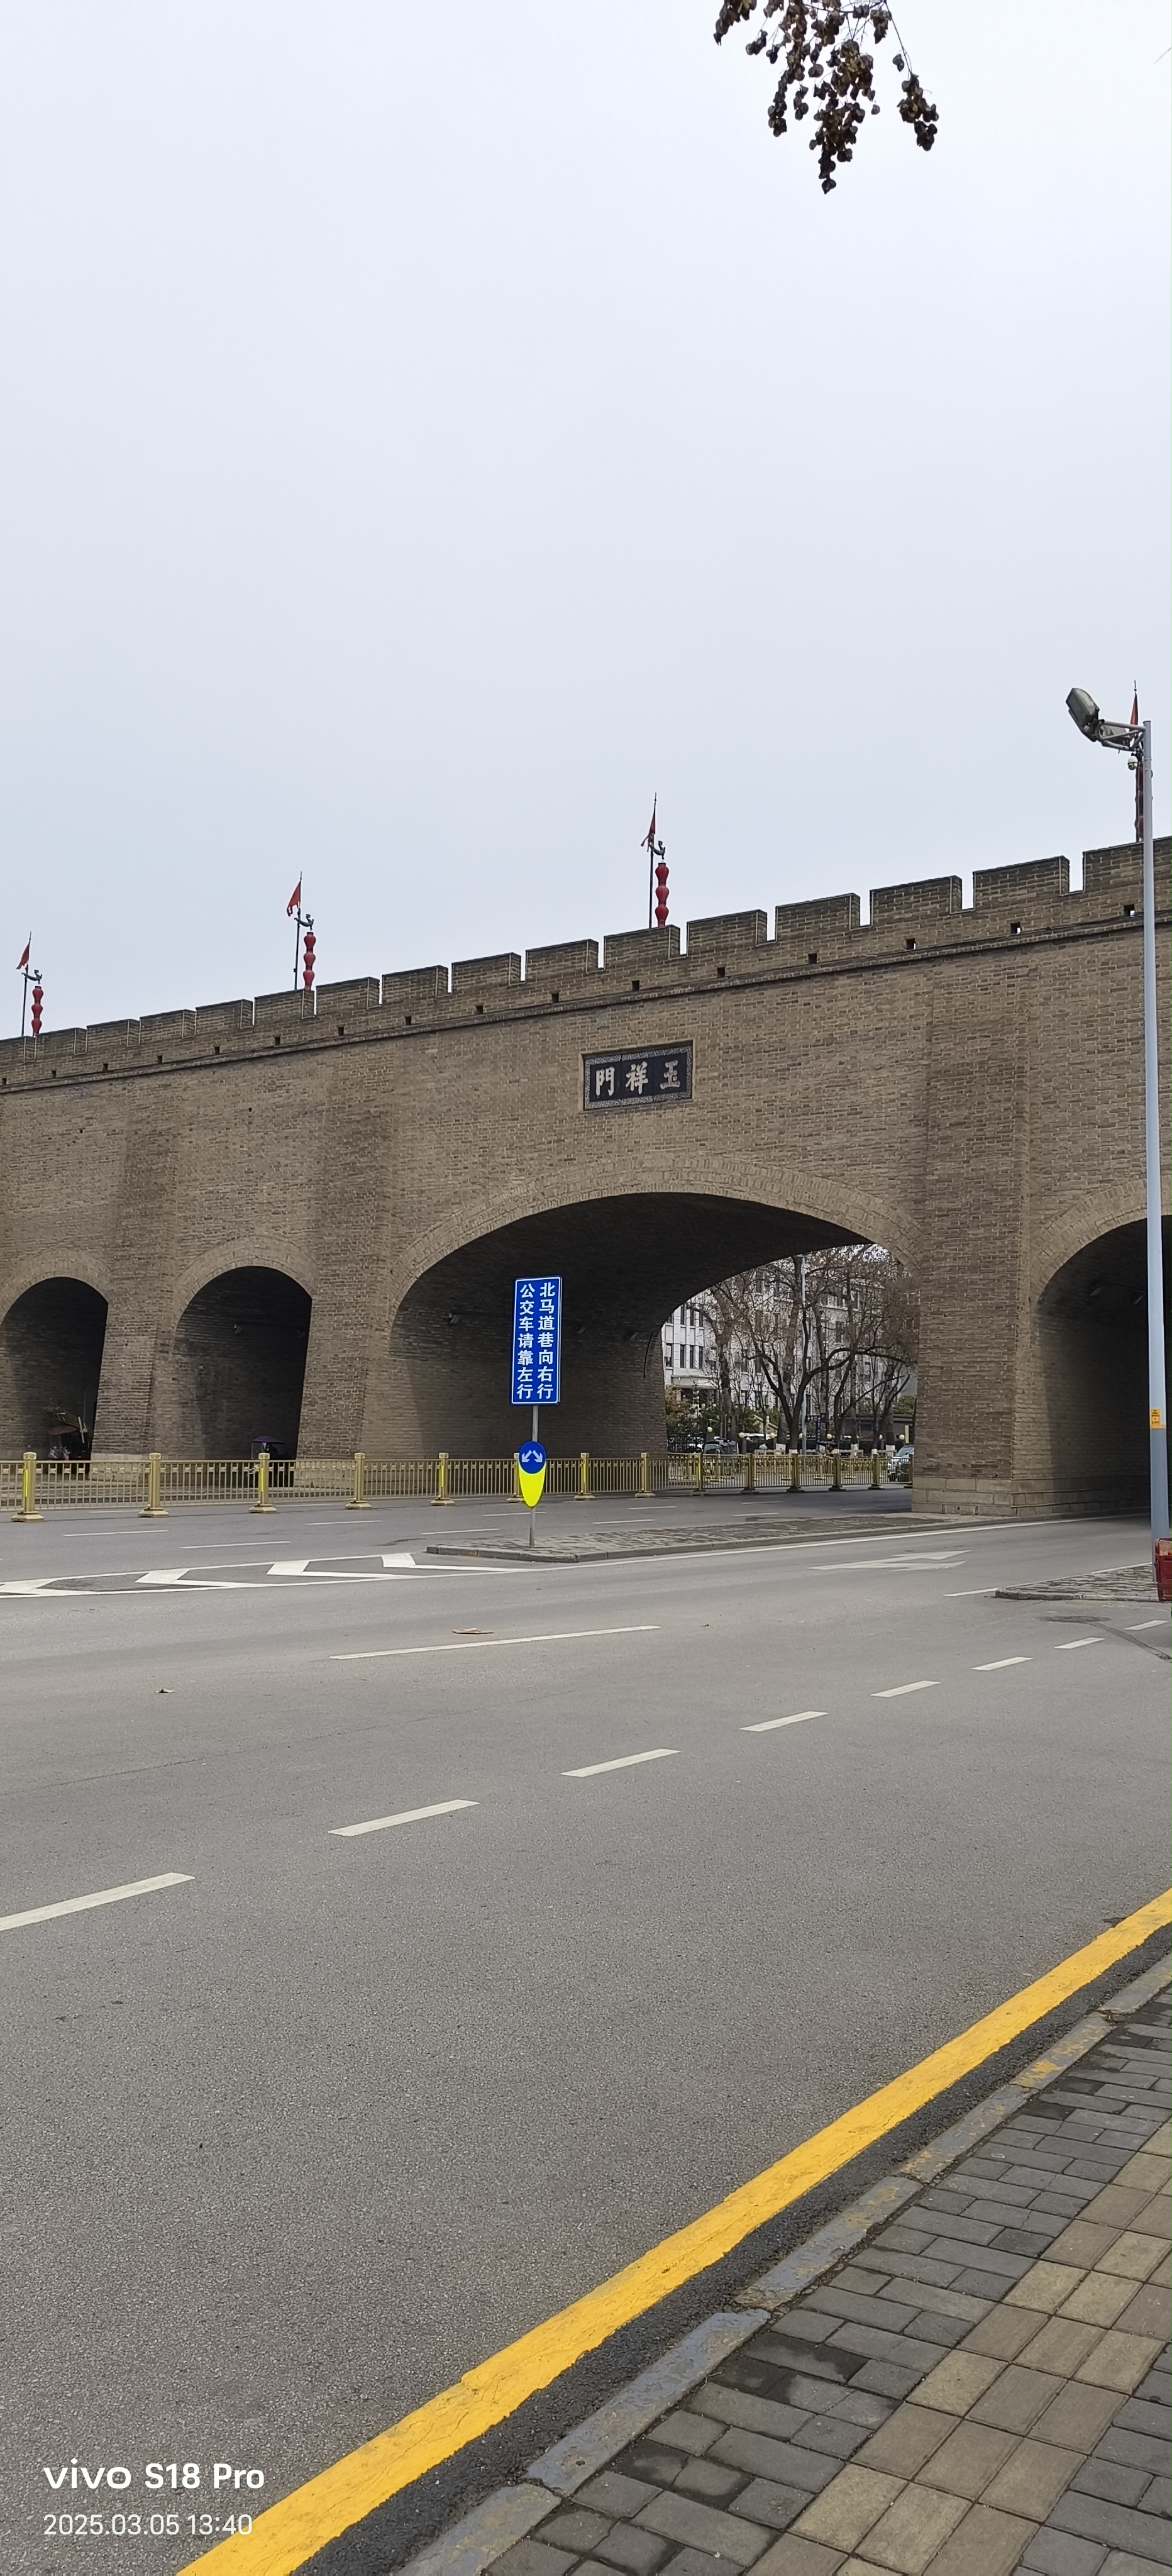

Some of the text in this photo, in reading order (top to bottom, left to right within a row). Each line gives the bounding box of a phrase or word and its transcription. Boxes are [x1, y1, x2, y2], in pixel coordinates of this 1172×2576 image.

[517, 1282, 535, 1400] 公交车请靠左行
[536, 1282, 556, 1400] 北马道巷向右行
